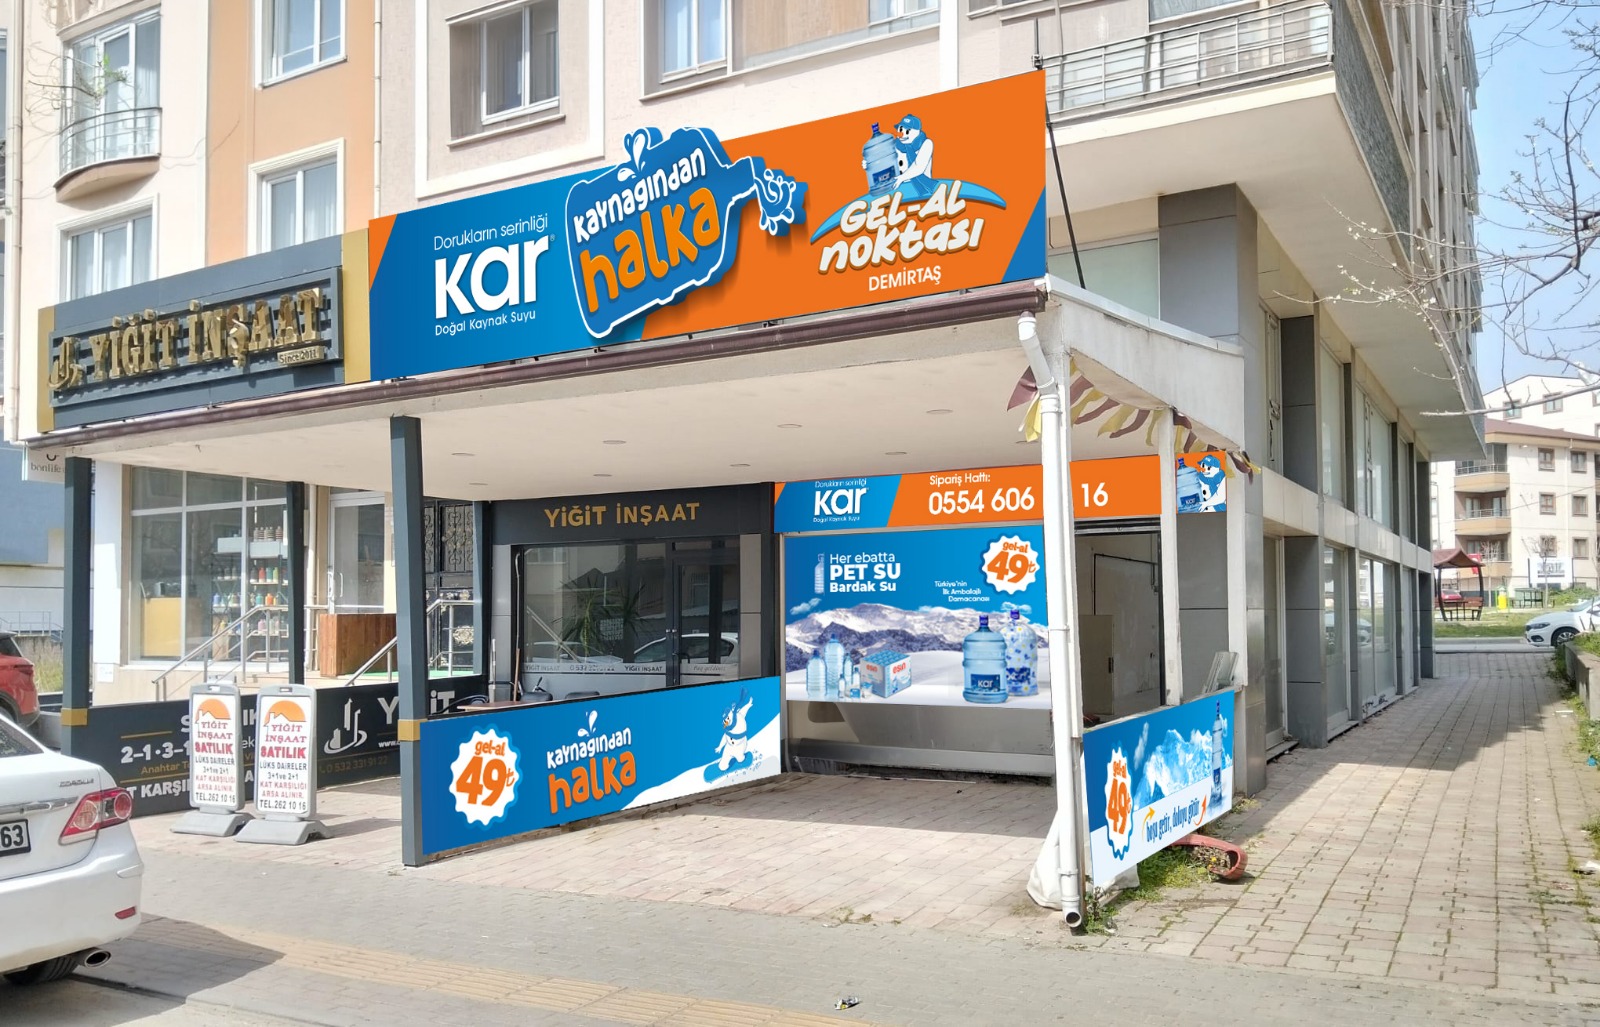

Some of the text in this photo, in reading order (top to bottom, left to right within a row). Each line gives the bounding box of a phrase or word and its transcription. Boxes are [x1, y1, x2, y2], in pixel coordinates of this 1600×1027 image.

[840, 180, 966, 235] GEL-AL
[434, 213, 548, 251] Dorukların serinliği
[579, 187, 720, 313] halka
[818, 218, 985, 274] noktası
[868, 265, 942, 291] DEMİRTAŞ
[435, 310, 536, 336] Doğal Kaynak Suyu
[88, 287, 324, 381] YİĞİT İNŞAAT
[929, 473, 991, 487] Sipariş Hattı:
[928, 482, 1109, 515] 0554 606 16
[544, 502, 700, 528] YİĞİT İNŞAAT
[1002, 541, 1028, 554] gel-al
[829, 552, 895, 564] Her ebatta
[829, 563, 901, 581] PET SU
[829, 581, 897, 593] Bardak Su
[271, 723, 303, 732] YİĞİT
[265, 735, 307, 744] İNŞAAT
[195, 742, 234, 754] SATILIK
[260, 746, 306, 759] SATILIK
[474, 740, 506, 757] gel-al
[195, 755, 209, 764] LÜKS
[260, 761, 275, 769] LÜKS
[141, 763, 180, 775] Anahtar
[548, 750, 637, 814] halka
[289, 800, 297, 810] 10
